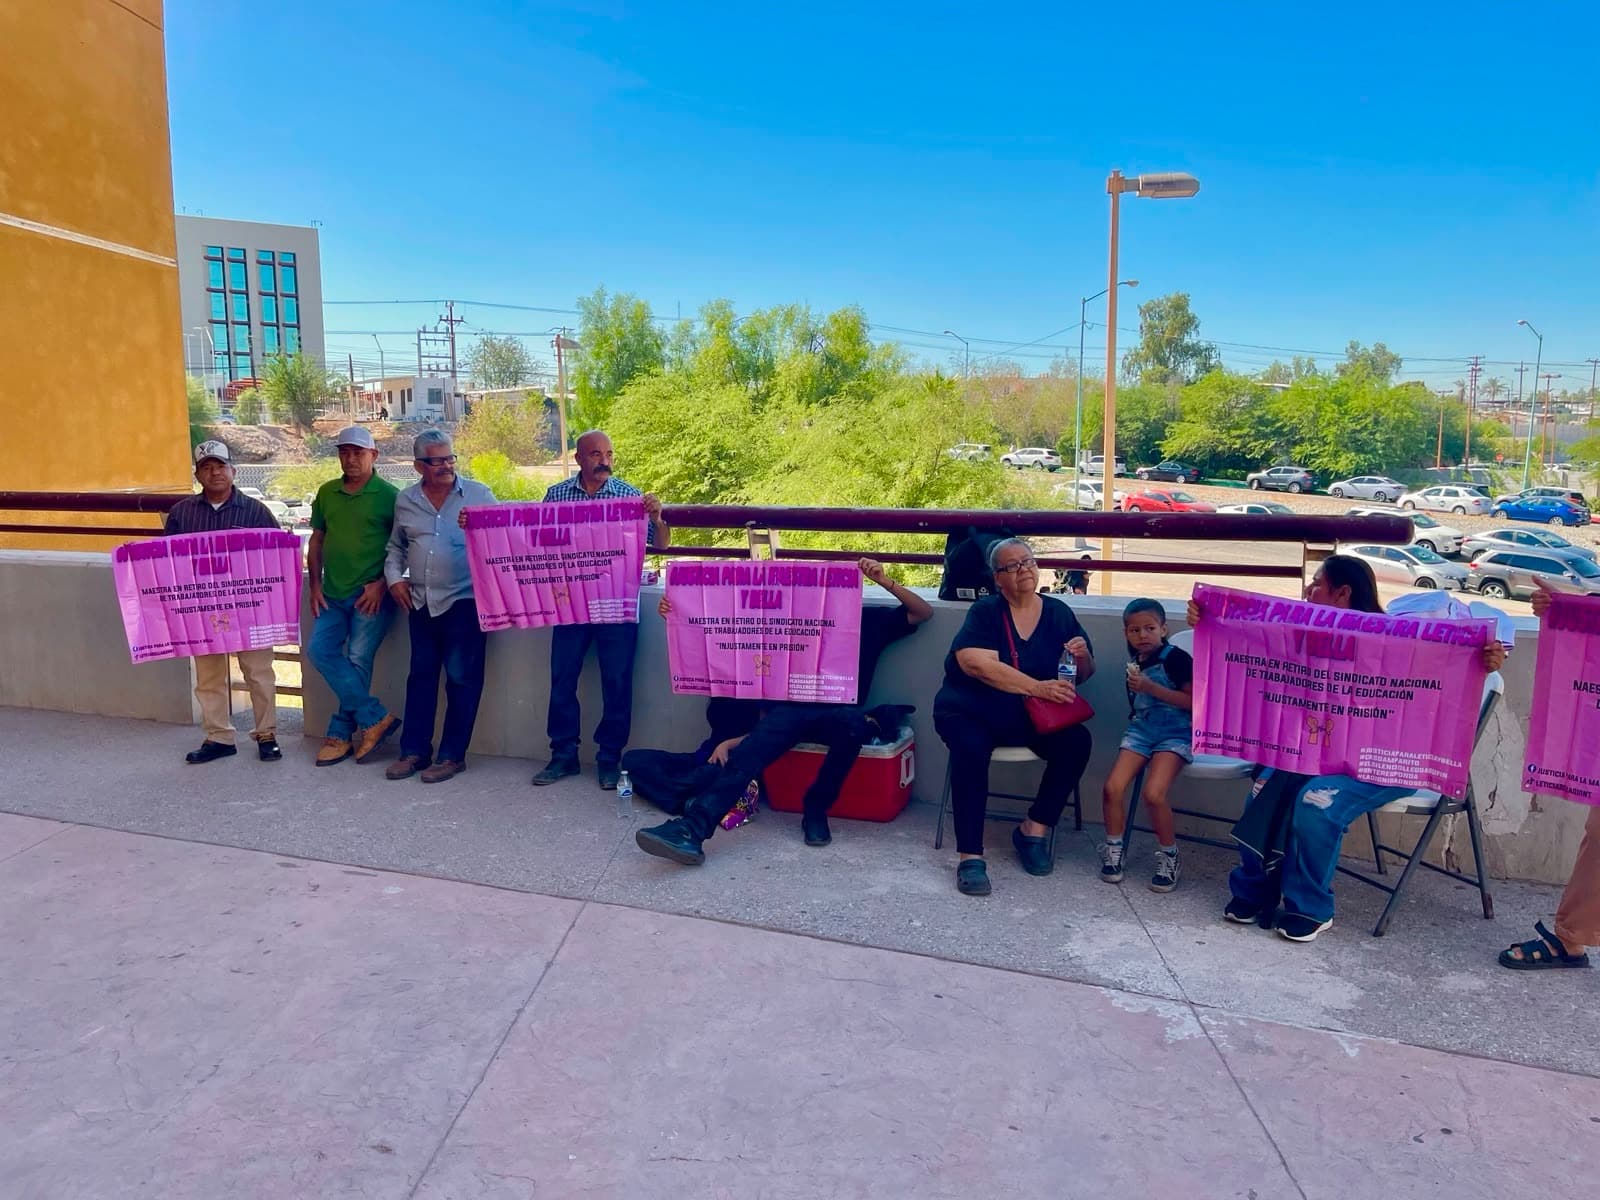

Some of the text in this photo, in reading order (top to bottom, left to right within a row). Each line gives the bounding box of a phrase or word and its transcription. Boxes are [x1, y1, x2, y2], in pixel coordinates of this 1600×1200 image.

[525, 554, 547, 562] RETIRO
[549, 553, 560, 561] DEL
[561, 551, 595, 560] SINDICATO
[595, 549, 627, 558] NACIONAL
[501, 565, 511, 573] DE
[567, 561, 576, 569] LA
[565, 575, 574, 583] EN
[141, 576, 287, 596] MAESTRA EN RETIRO DEL SINDICATO NACIONAL
[160, 594, 168, 602] DE
[218, 589, 227, 597] DE
[228, 588, 236, 596] LA
[224, 602, 234, 610] EN
[688, 617, 836, 628] MAESTRA EN RETIRO DEL SINDICATO NACIONAL
[1269, 602, 1314, 626] PARA
[1314, 609, 1337, 629] LA
[1337, 613, 1420, 639] MAESTRA
[1421, 622, 1488, 648] LETICIA
[703, 626, 821, 637] DE TRABAJADORES DE LA EDUCACIÓN
[769, 643, 778, 651] EN
[1225, 652, 1443, 691] MAESTRA EN RETIRO DEL SINDICATO NACIONAL
[1246, 668, 1414, 701] DE TRABAJADORES DE LA EDUCACIÓN
[1331, 704, 1344, 716] EN
